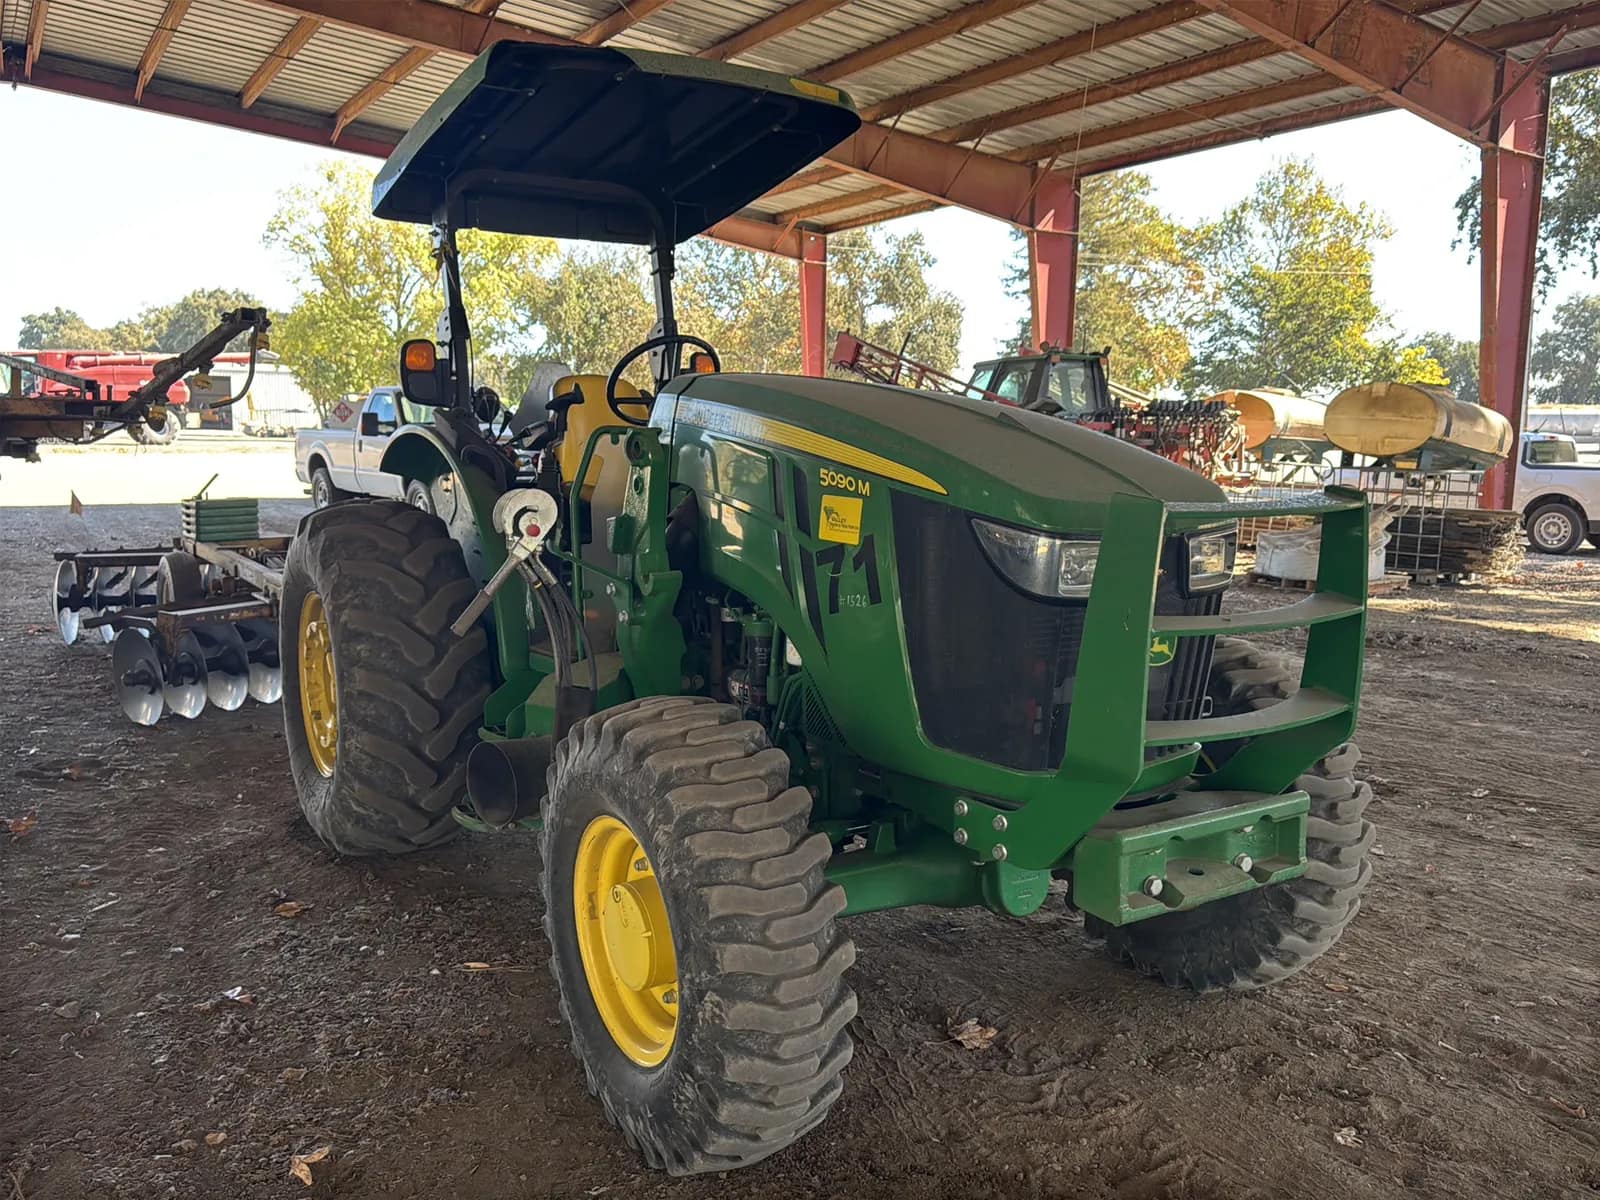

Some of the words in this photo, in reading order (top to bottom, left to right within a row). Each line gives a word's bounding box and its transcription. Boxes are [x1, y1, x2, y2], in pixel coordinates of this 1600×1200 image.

[820, 468, 855, 491] 5090
[858, 480, 870, 496] M
[816, 534, 882, 614] 71
